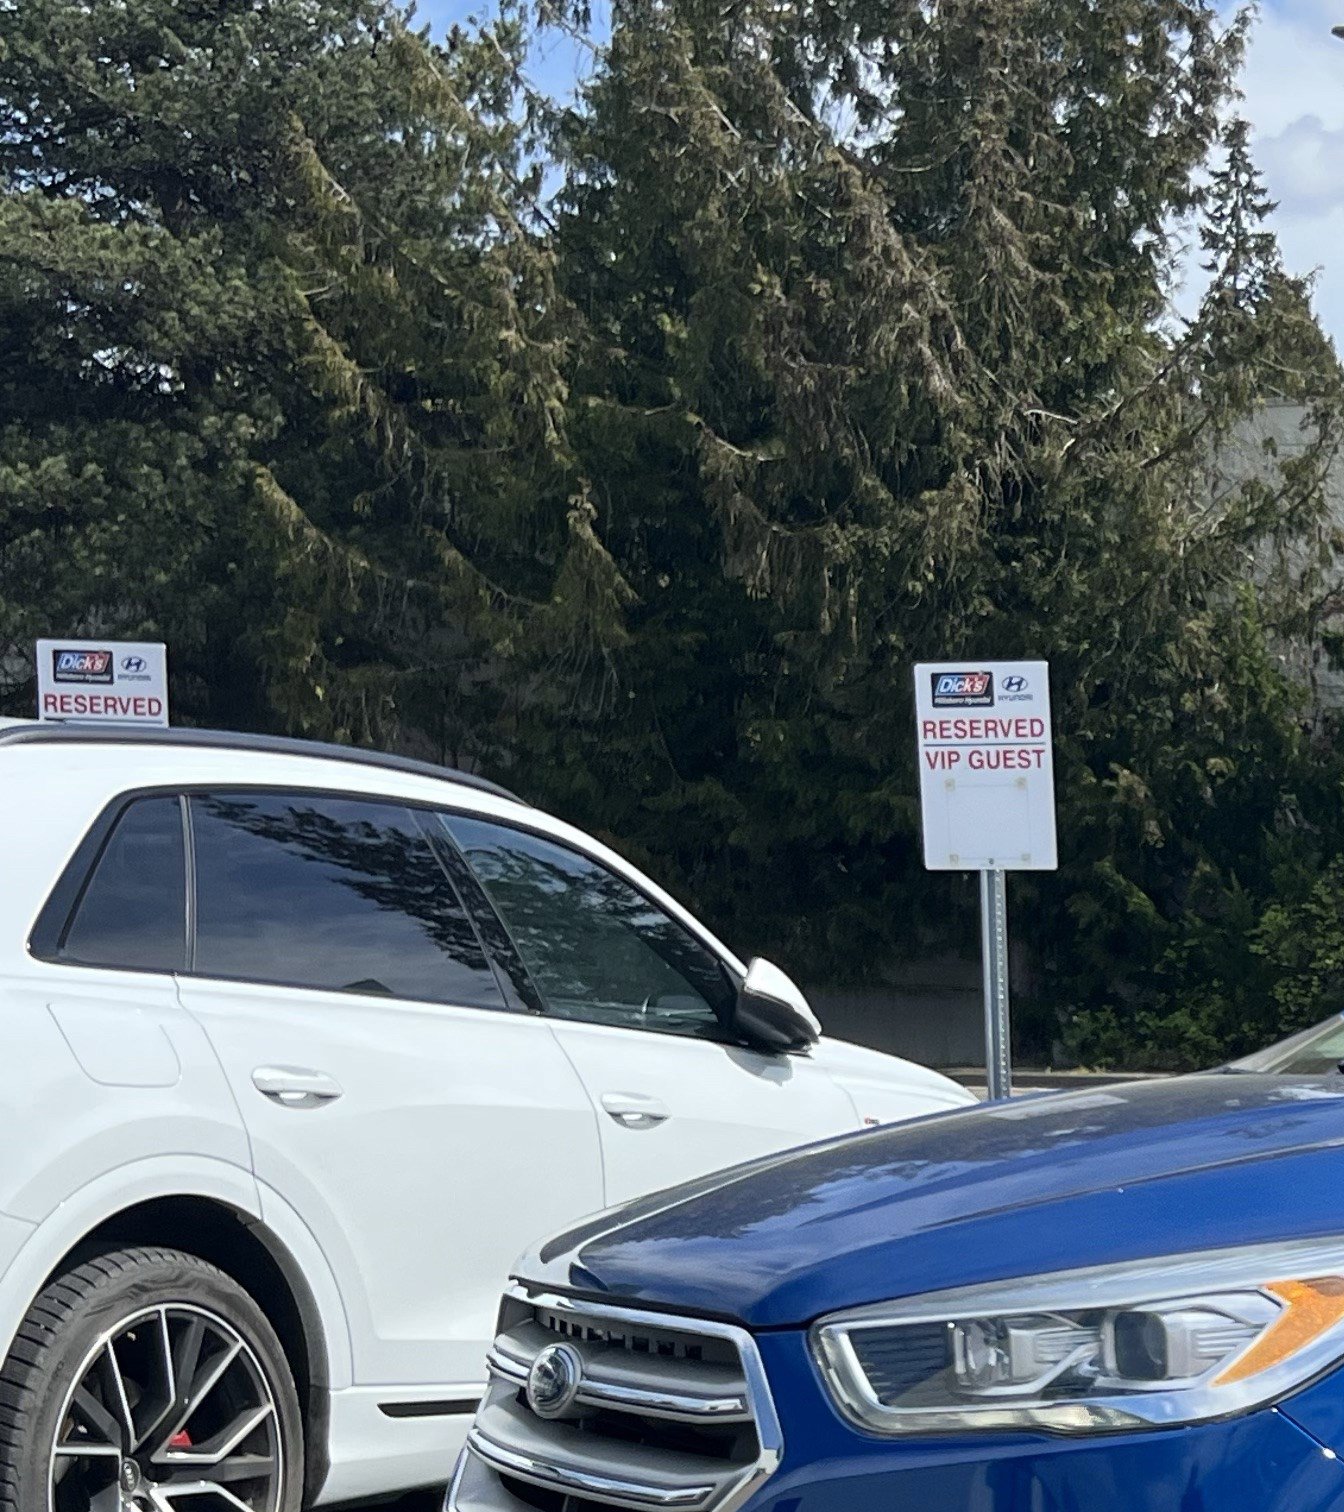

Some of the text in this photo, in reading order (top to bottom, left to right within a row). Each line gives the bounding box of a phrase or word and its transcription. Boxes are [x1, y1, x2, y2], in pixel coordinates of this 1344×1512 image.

[940, 676, 983, 693] Dick's
[44, 694, 162, 716] RESERVED
[923, 719, 1045, 739] RESERVED
[925, 750, 1046, 770] VIP GUEST
